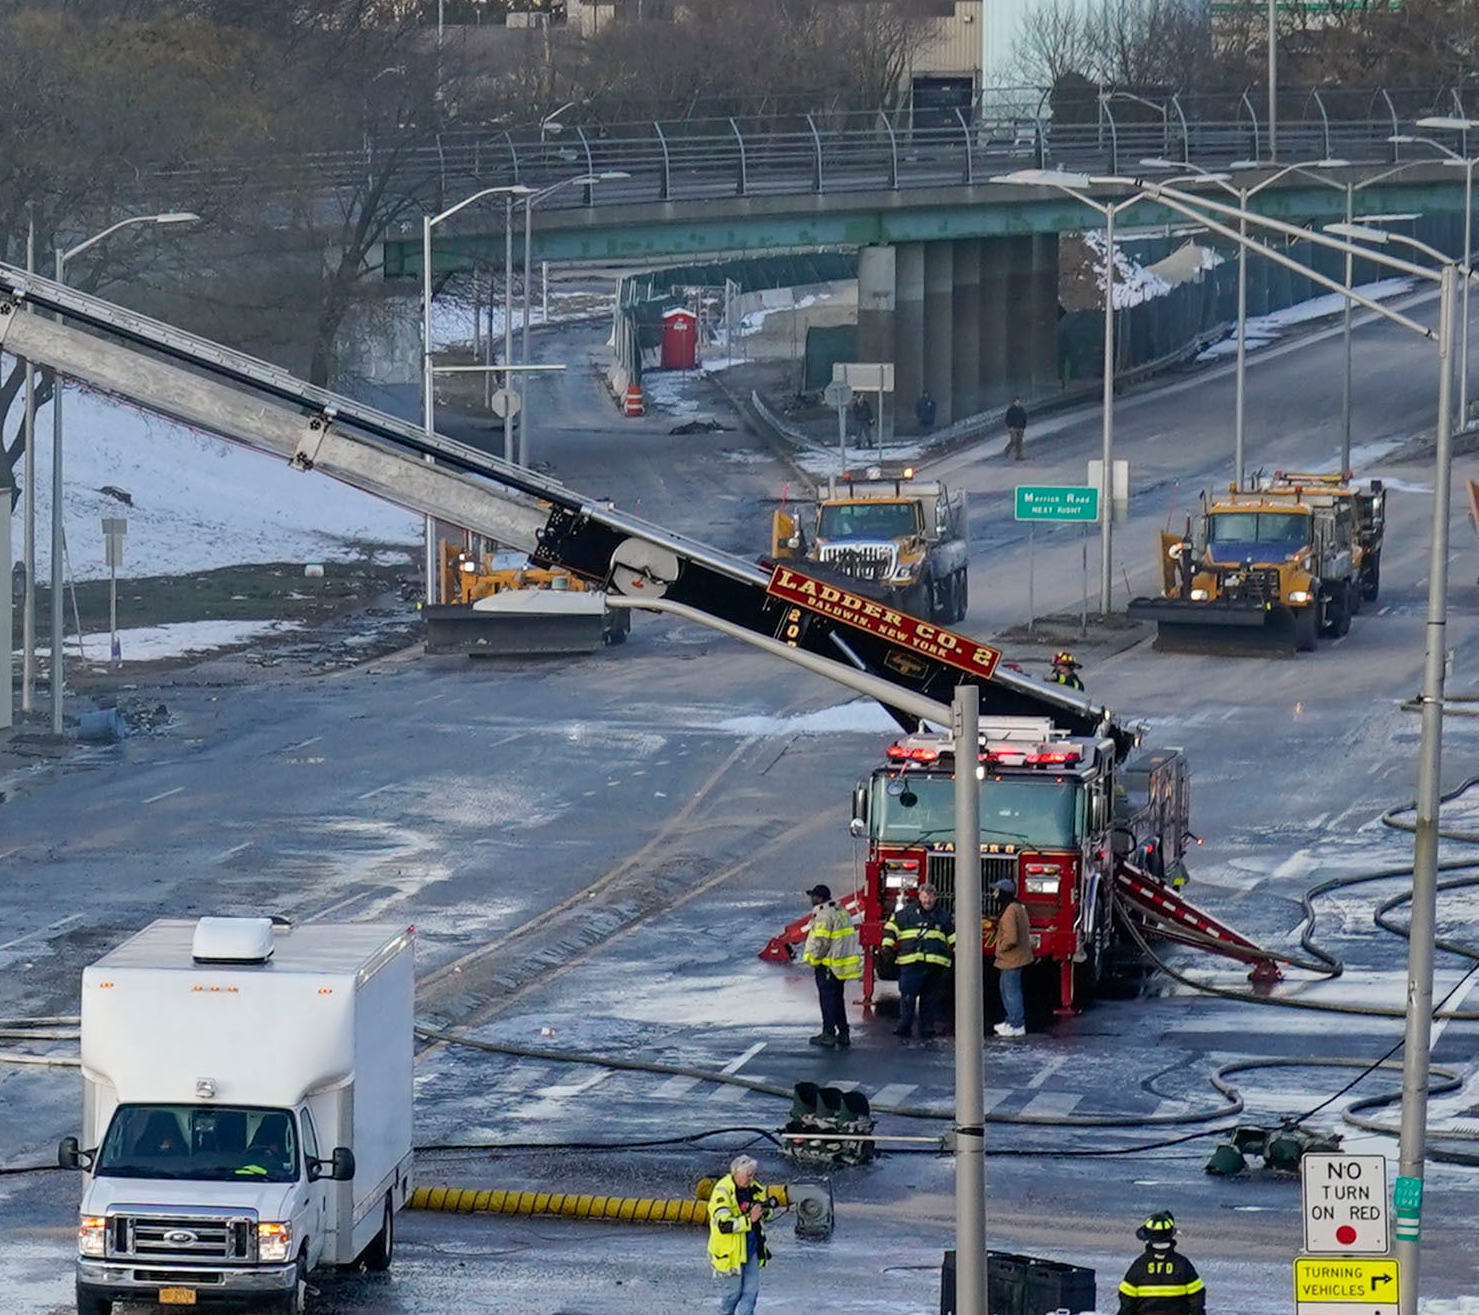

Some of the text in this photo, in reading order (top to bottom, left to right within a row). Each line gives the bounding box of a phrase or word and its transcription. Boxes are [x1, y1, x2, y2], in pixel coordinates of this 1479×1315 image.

[777, 569, 993, 668] LADDER CO. 2
[877, 624, 906, 642] NEW
[912, 636, 948, 658] YORK
[1327, 1161, 1362, 1180] NO
[1322, 1185, 1370, 1200] TURN
[1311, 1206, 1381, 1221] ON RED
[1147, 1261, 1174, 1274] SFD
[1304, 1266, 1363, 1279] TURNING
[1302, 1284, 1365, 1297] VEHICLES
